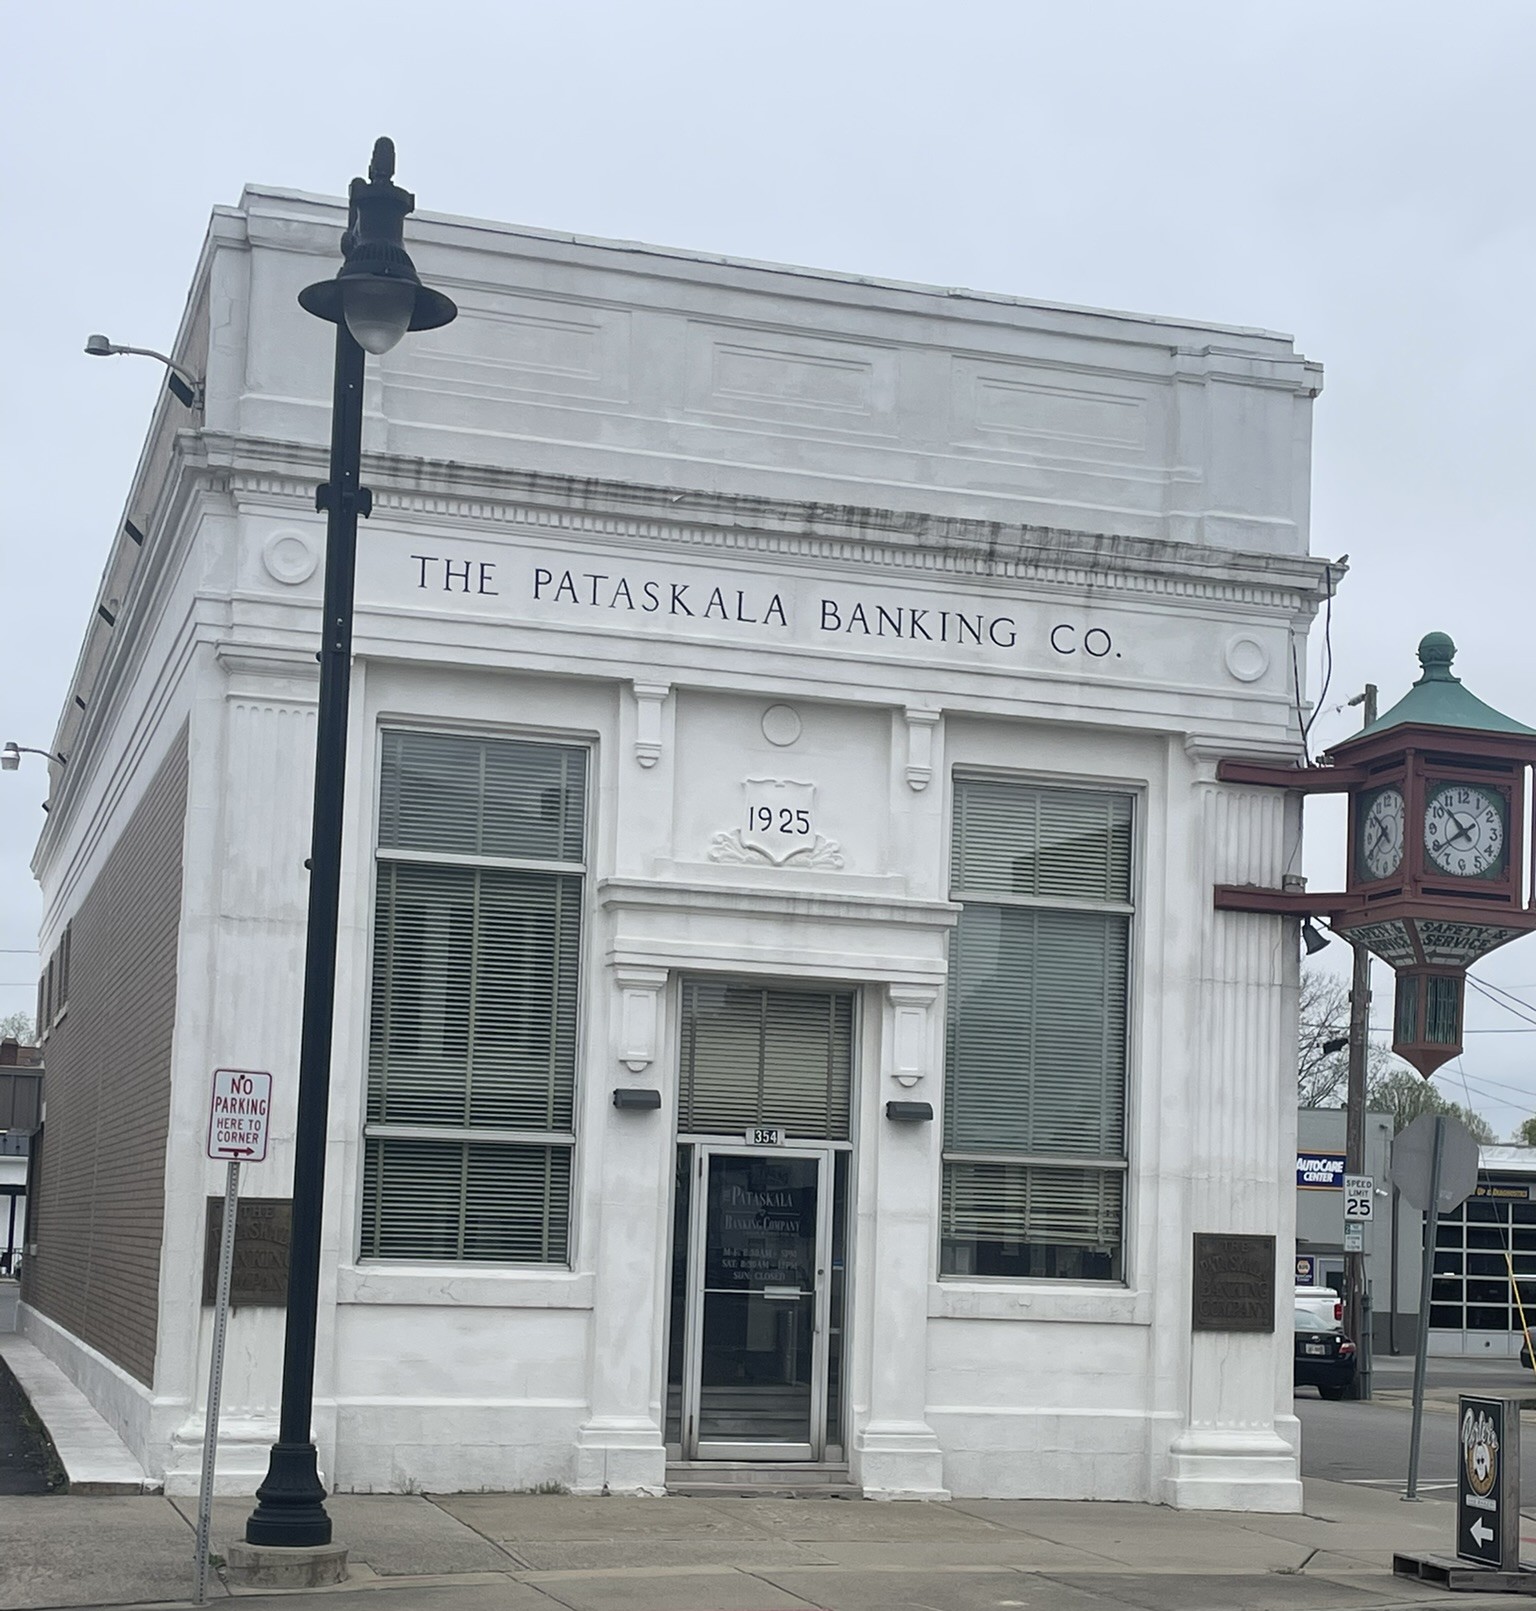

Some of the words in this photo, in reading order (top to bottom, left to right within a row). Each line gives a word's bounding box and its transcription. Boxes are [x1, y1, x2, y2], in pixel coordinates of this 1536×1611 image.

[410, 554, 499, 596] THE
[533, 568, 788, 626] PATASKALA
[820, 599, 1017, 648] BANKING
[1050, 624, 1122, 658] CO.
[1444, 795, 1453, 807] 11
[1458, 791, 1470, 804] 12
[1476, 797, 1480, 810] 1
[1433, 806, 1445, 819] 10
[1486, 811, 1495, 823] 2
[750, 806, 809, 834] 1925
[1429, 823, 1437, 835] 9
[1489, 828, 1498, 841] 3
[1484, 845, 1493, 857] 4
[1444, 853, 1451, 866] 7
[1458, 859, 1466, 871] 6
[1473, 856, 1482, 869] 5
[1420, 921, 1489, 937] SAFETY
[1492, 930, 1508, 940] &
[1423, 934, 1491, 950] SERVICE
[231, 1077, 253, 1095] NO
[215, 1096, 267, 1116] PARKING
[217, 1118, 244, 1130] HERE
[249, 1119, 261, 1131] TO
[217, 1131, 259, 1144] CORNER
[754, 1130, 777, 1144] 354
[1303, 1172, 1334, 1182] CENTER
[1346, 1180, 1372, 1188] SPEED
[732, 1185, 793, 1207] PATASKALA
[242, 1206, 275, 1219] THE
[1347, 1199, 1371, 1216] 25
[725, 1214, 762, 1230] BANKING
[763, 1217, 800, 1232] COMPANY
[754, 1271, 786, 1281] CLOSED
